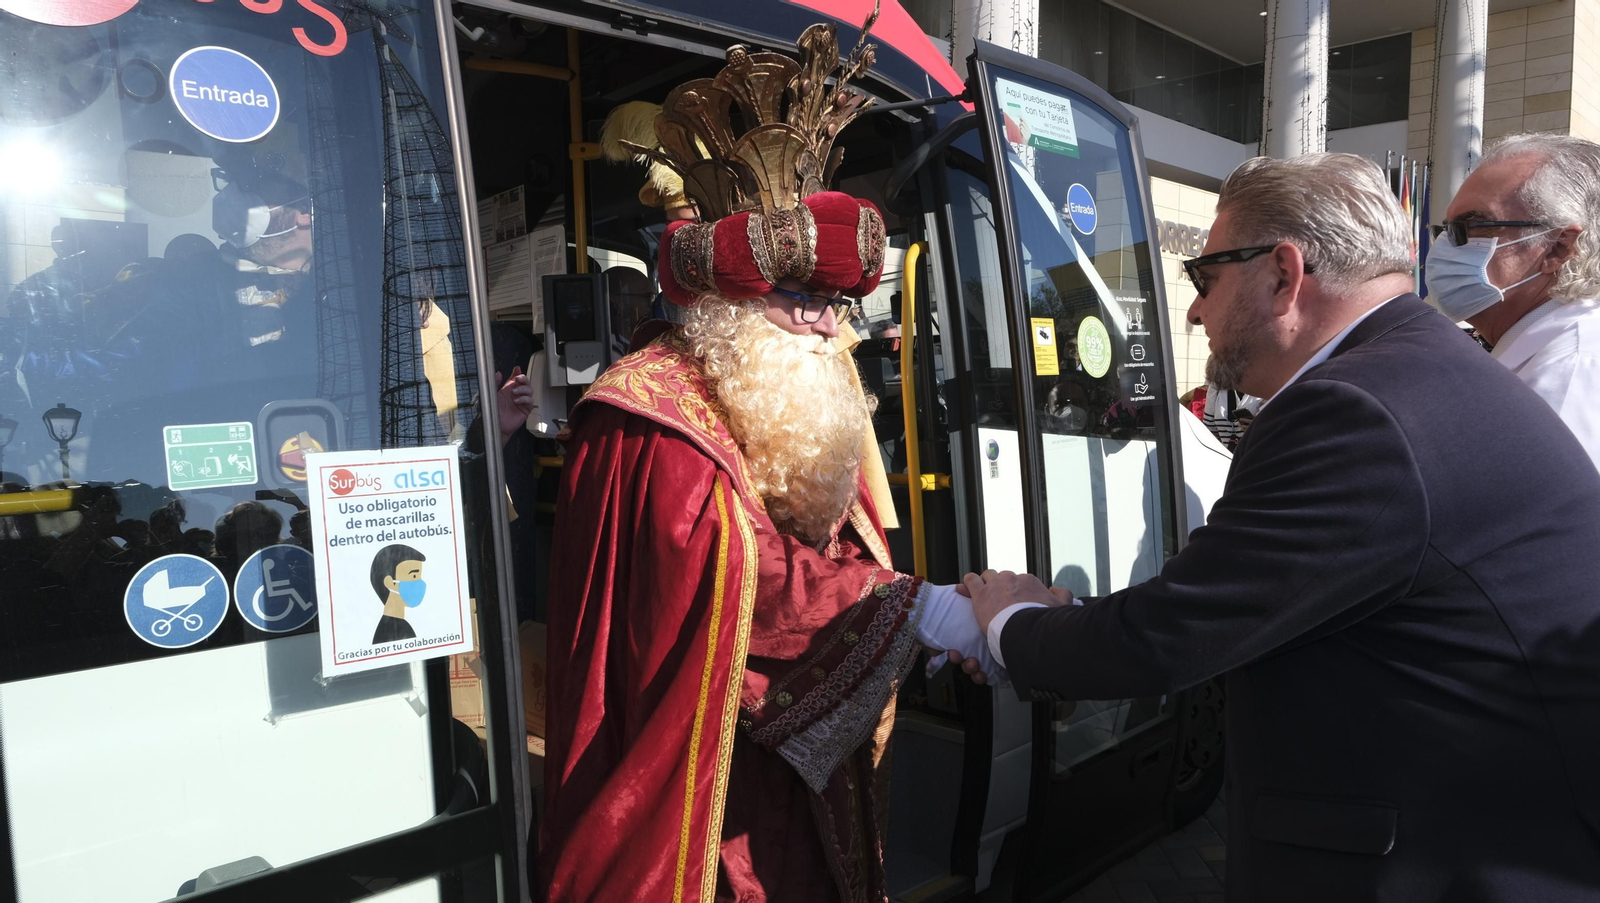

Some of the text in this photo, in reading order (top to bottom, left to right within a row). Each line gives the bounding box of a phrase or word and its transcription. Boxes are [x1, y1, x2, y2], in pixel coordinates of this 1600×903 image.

[182, 79, 270, 109] Entrada
[1005, 86, 1022, 99] Aquí
[1022, 93, 1047, 107] puedes
[1025, 106, 1069, 125] con tu Tarjeta
[1070, 202, 1094, 216] Entrada
[1086, 336, 1104, 350] 99%
[394, 469, 445, 489] alsa
[338, 495, 437, 515] Uso obligatorio
[345, 511, 436, 530] de mascarillas
[329, 523, 453, 547] dentro del autobús.
[338, 633, 461, 661] Gracias por tu colaboración
